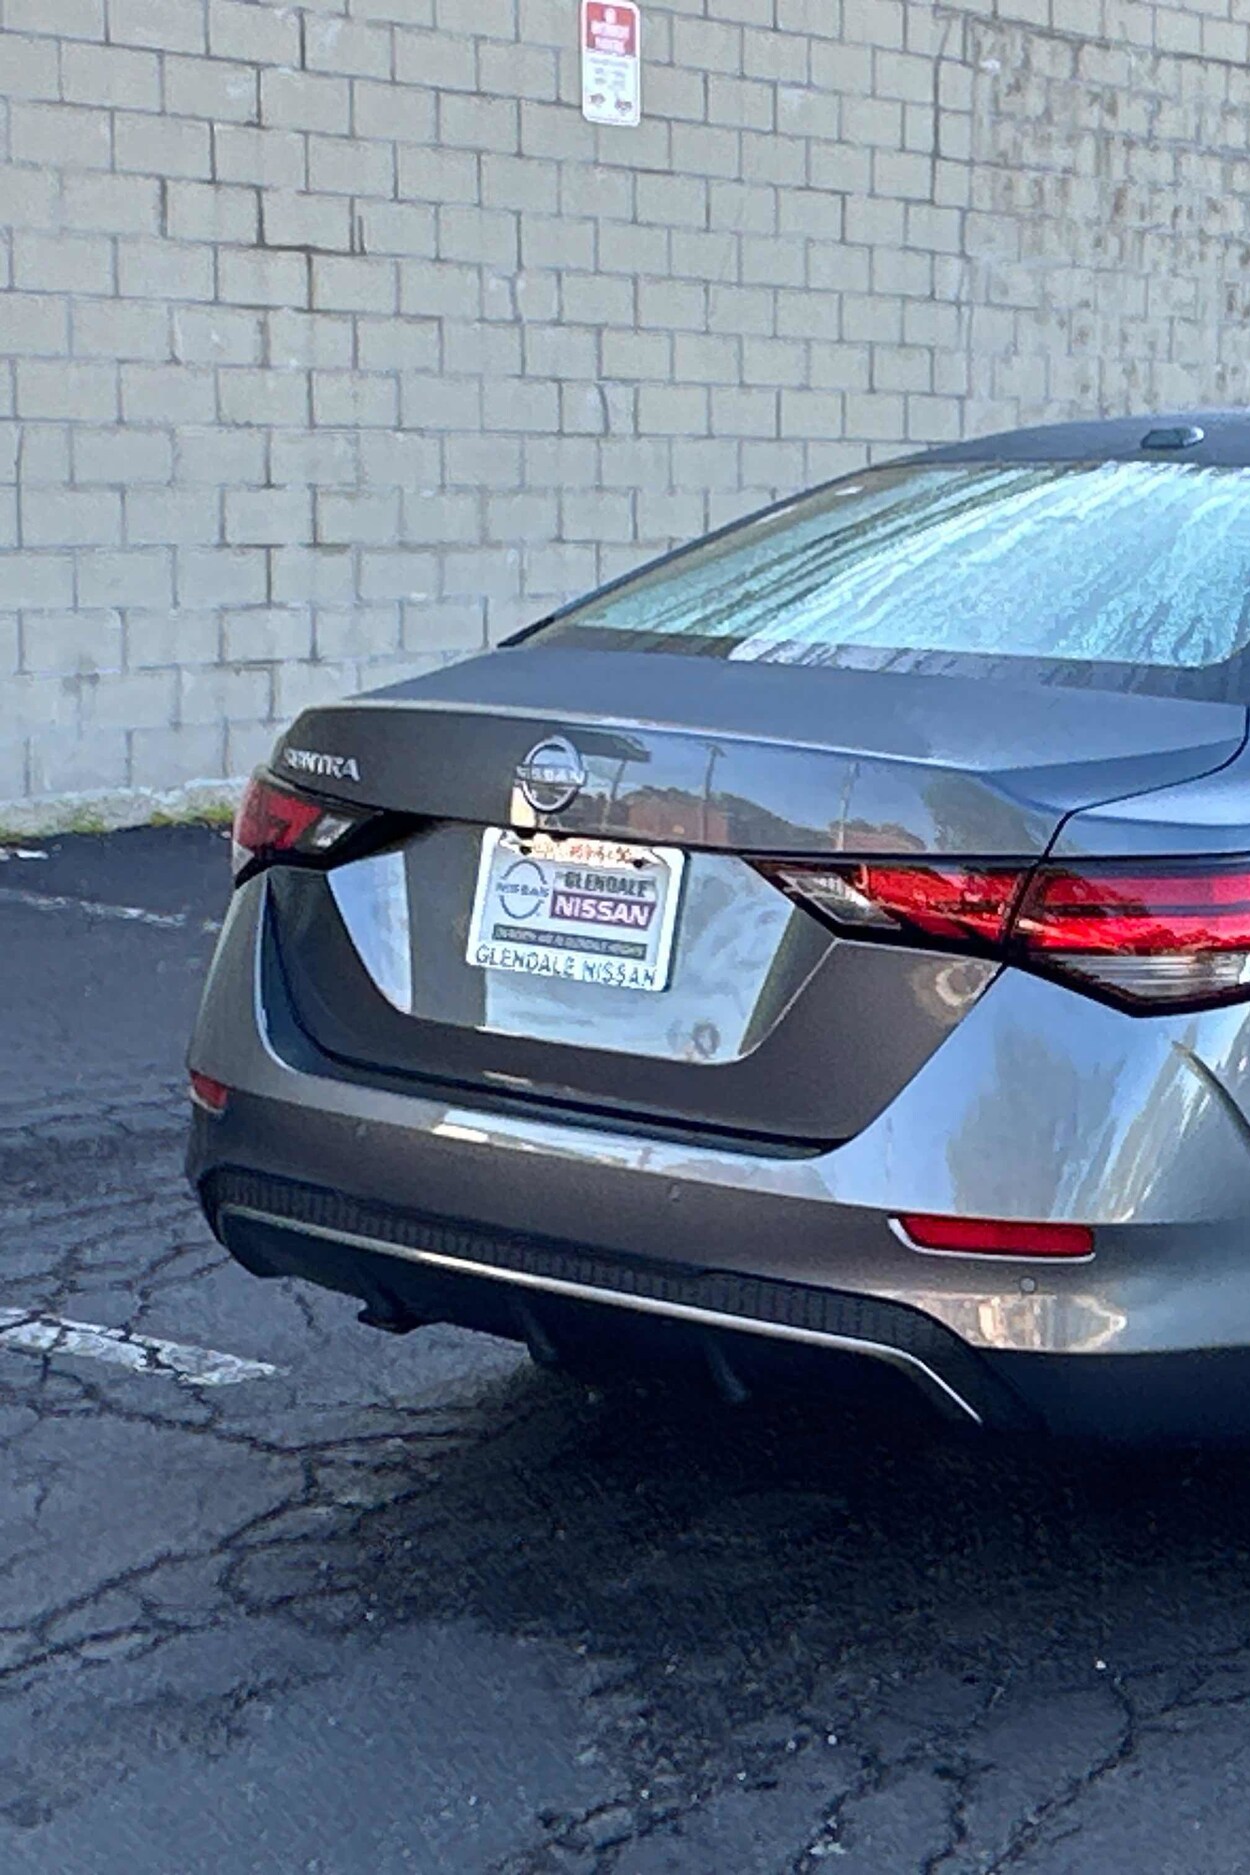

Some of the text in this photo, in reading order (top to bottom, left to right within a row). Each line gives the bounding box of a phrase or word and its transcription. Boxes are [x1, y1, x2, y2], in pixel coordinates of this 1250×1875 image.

[564, 871, 652, 898] GLENDALE
[554, 896, 650, 926] NISSAN
[476, 944, 657, 987] GLENDALE NISSAN
